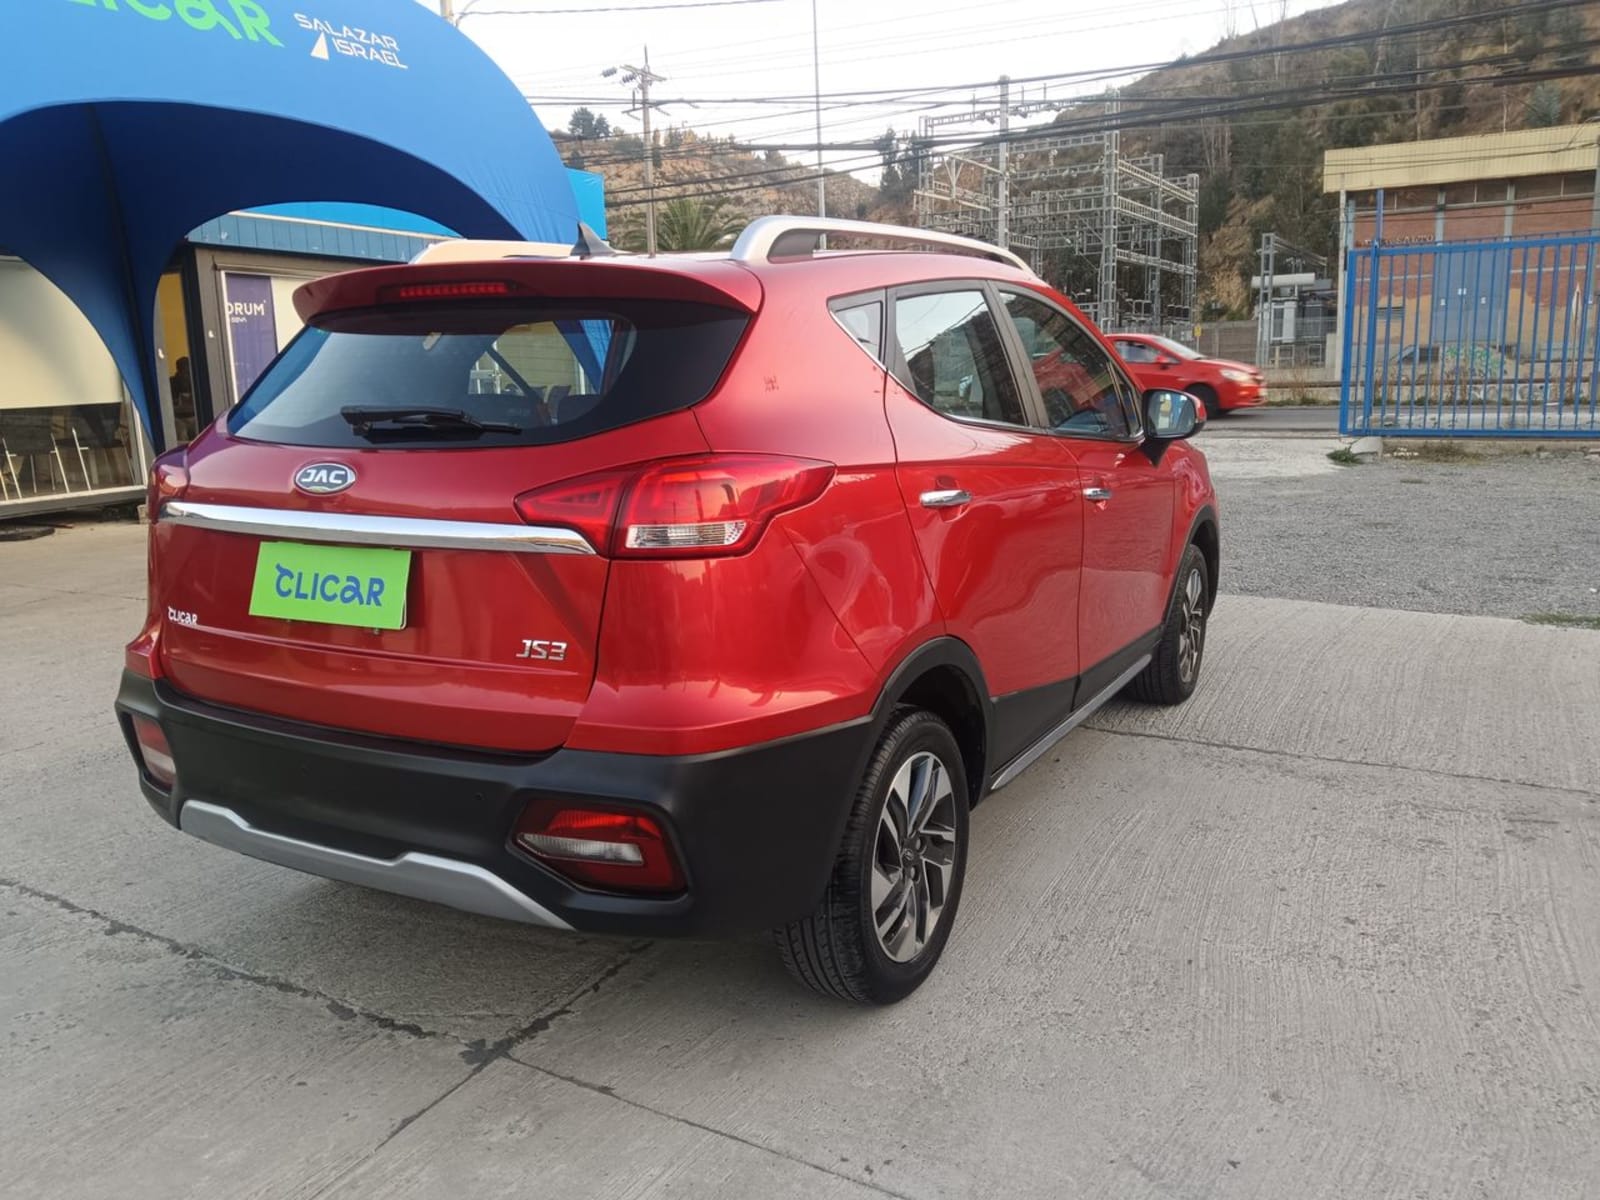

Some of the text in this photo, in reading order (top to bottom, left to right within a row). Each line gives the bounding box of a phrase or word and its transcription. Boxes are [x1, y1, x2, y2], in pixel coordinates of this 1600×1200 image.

[293, 12, 400, 51] SALAZAR
[331, 37, 408, 69] ISRAEL
[301, 469, 346, 484] JAC
[515, 639, 568, 661] JS3
